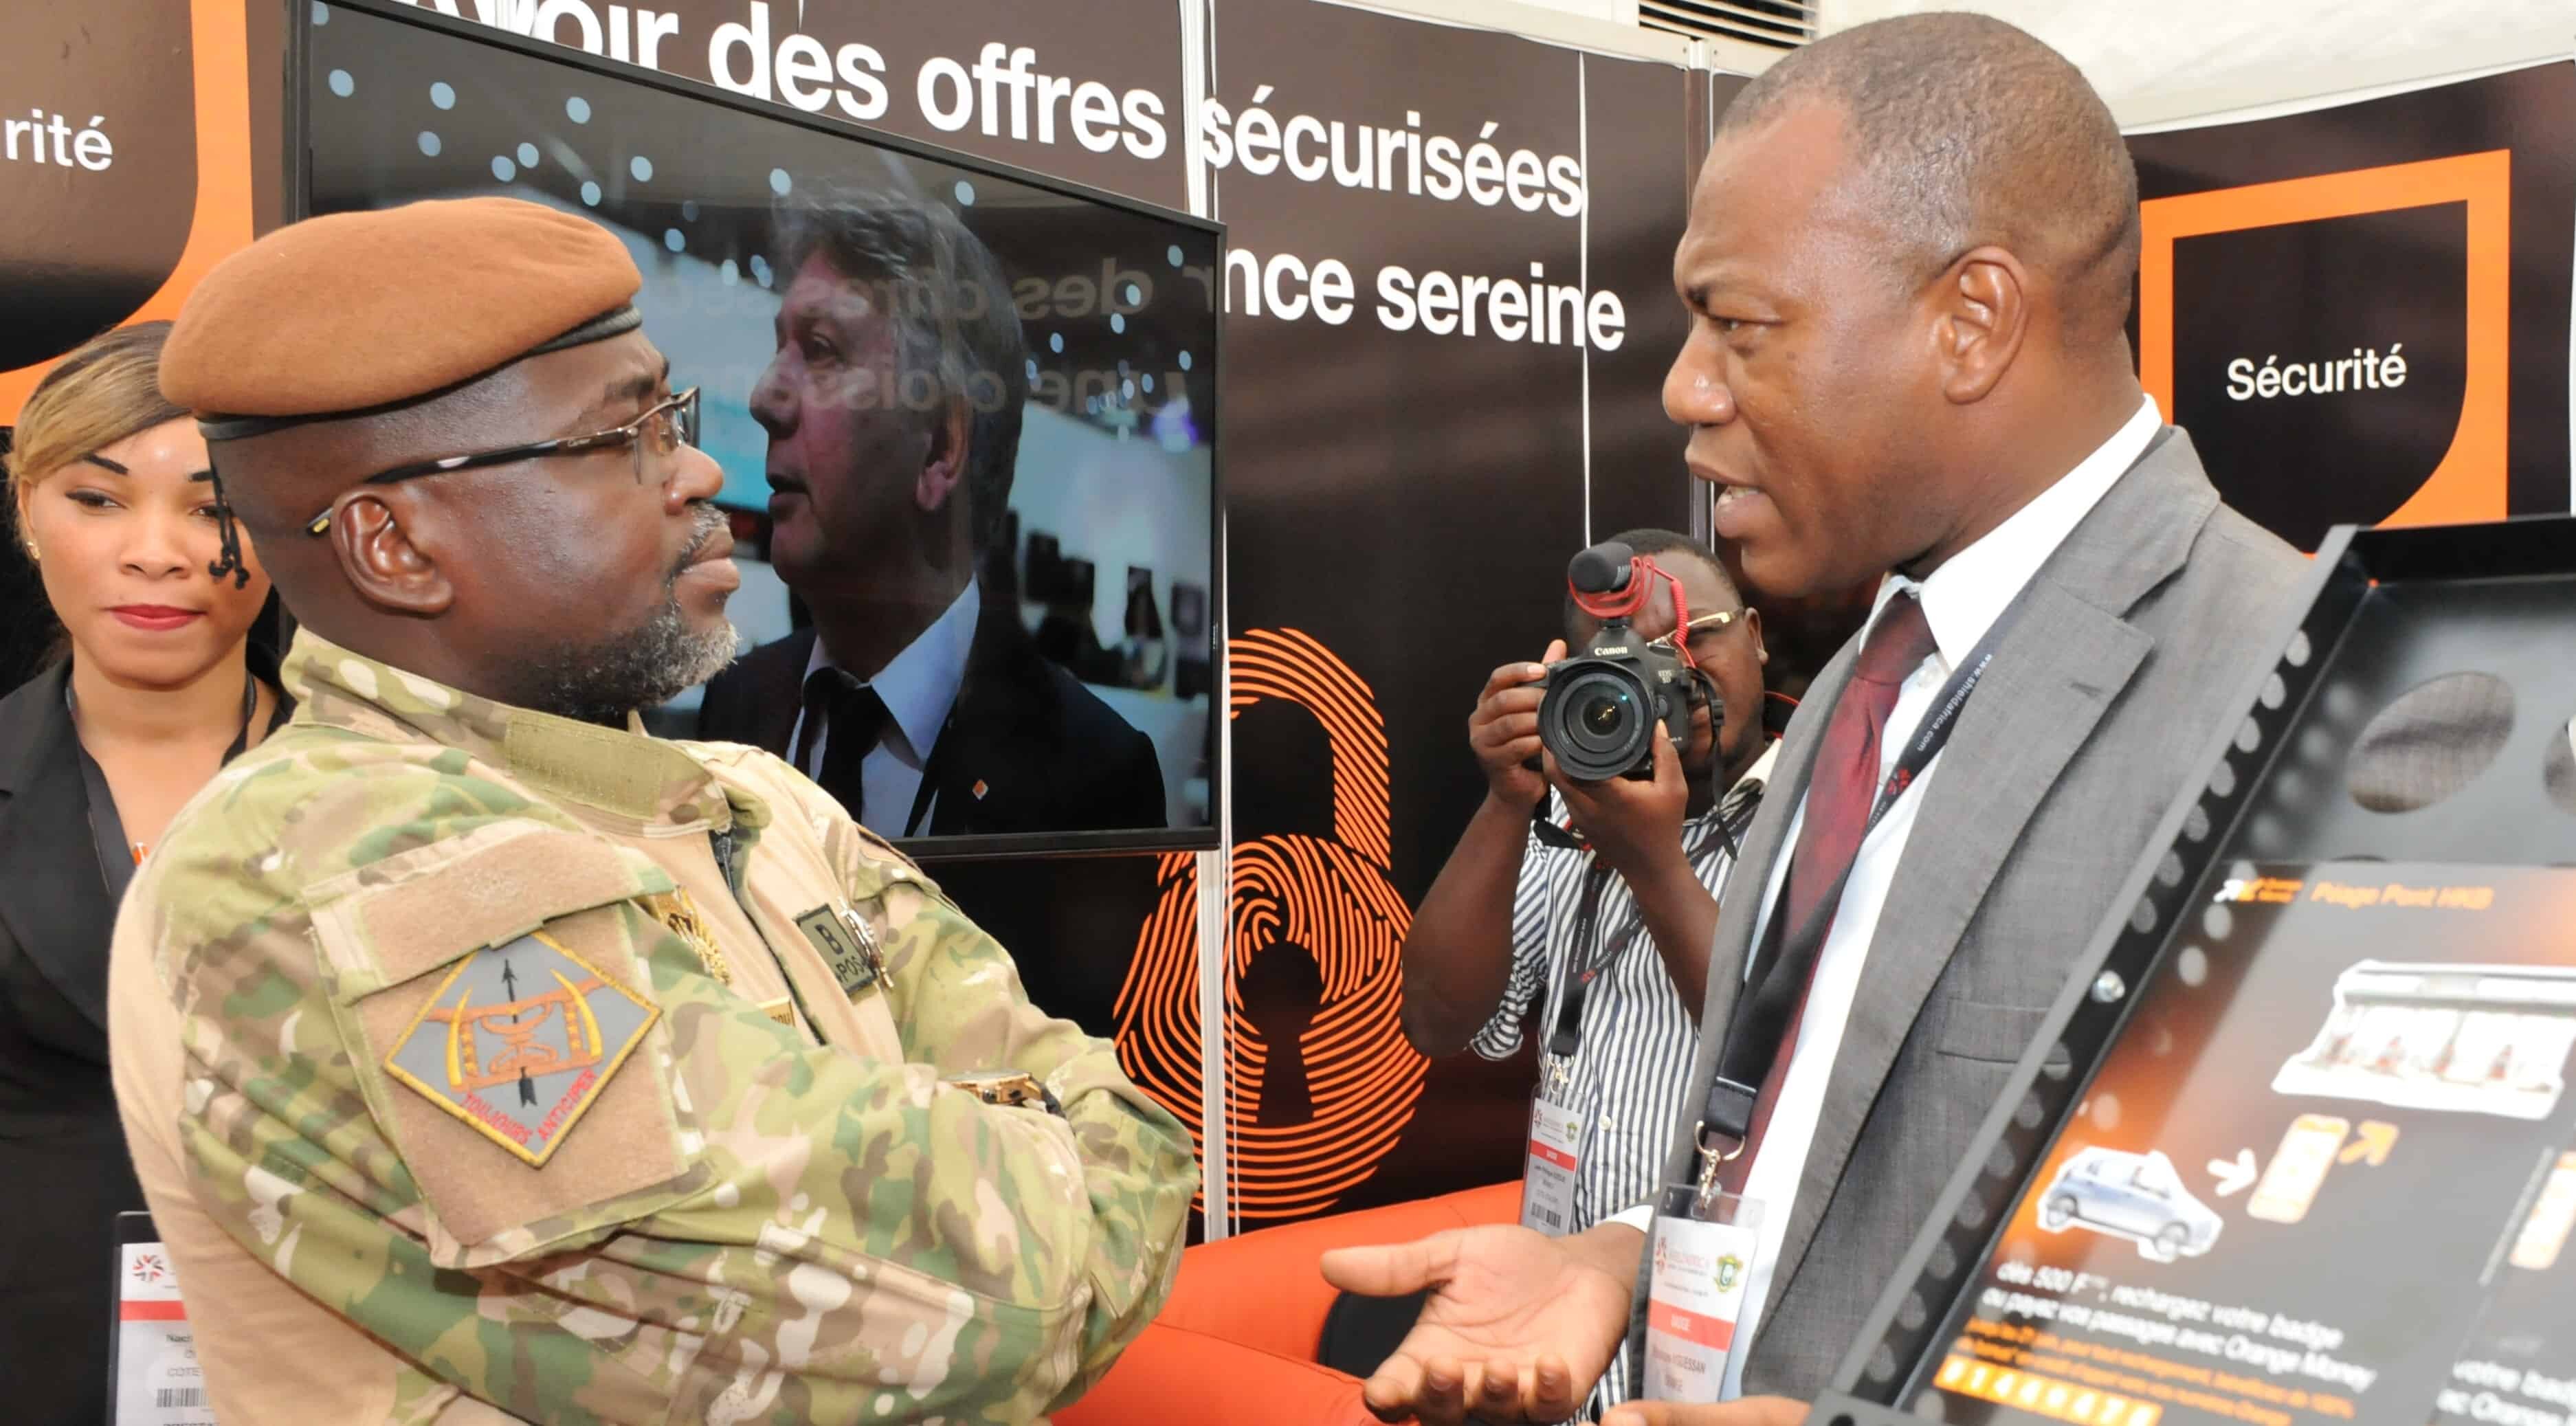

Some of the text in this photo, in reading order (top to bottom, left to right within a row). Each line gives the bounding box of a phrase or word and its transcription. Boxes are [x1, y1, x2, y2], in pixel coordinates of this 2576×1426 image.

[709, 0, 889, 120] des
[917, 42, 1166, 159] offres
[1203, 85, 1583, 216] sécurisées
[5, 109, 113, 170] rité
[1377, 262, 1625, 350] sereine
[2226, 343, 2406, 400] Sécurité
[1595, 646, 1628, 656] Canon
[2224, 1333, 2301, 1376] Orange
